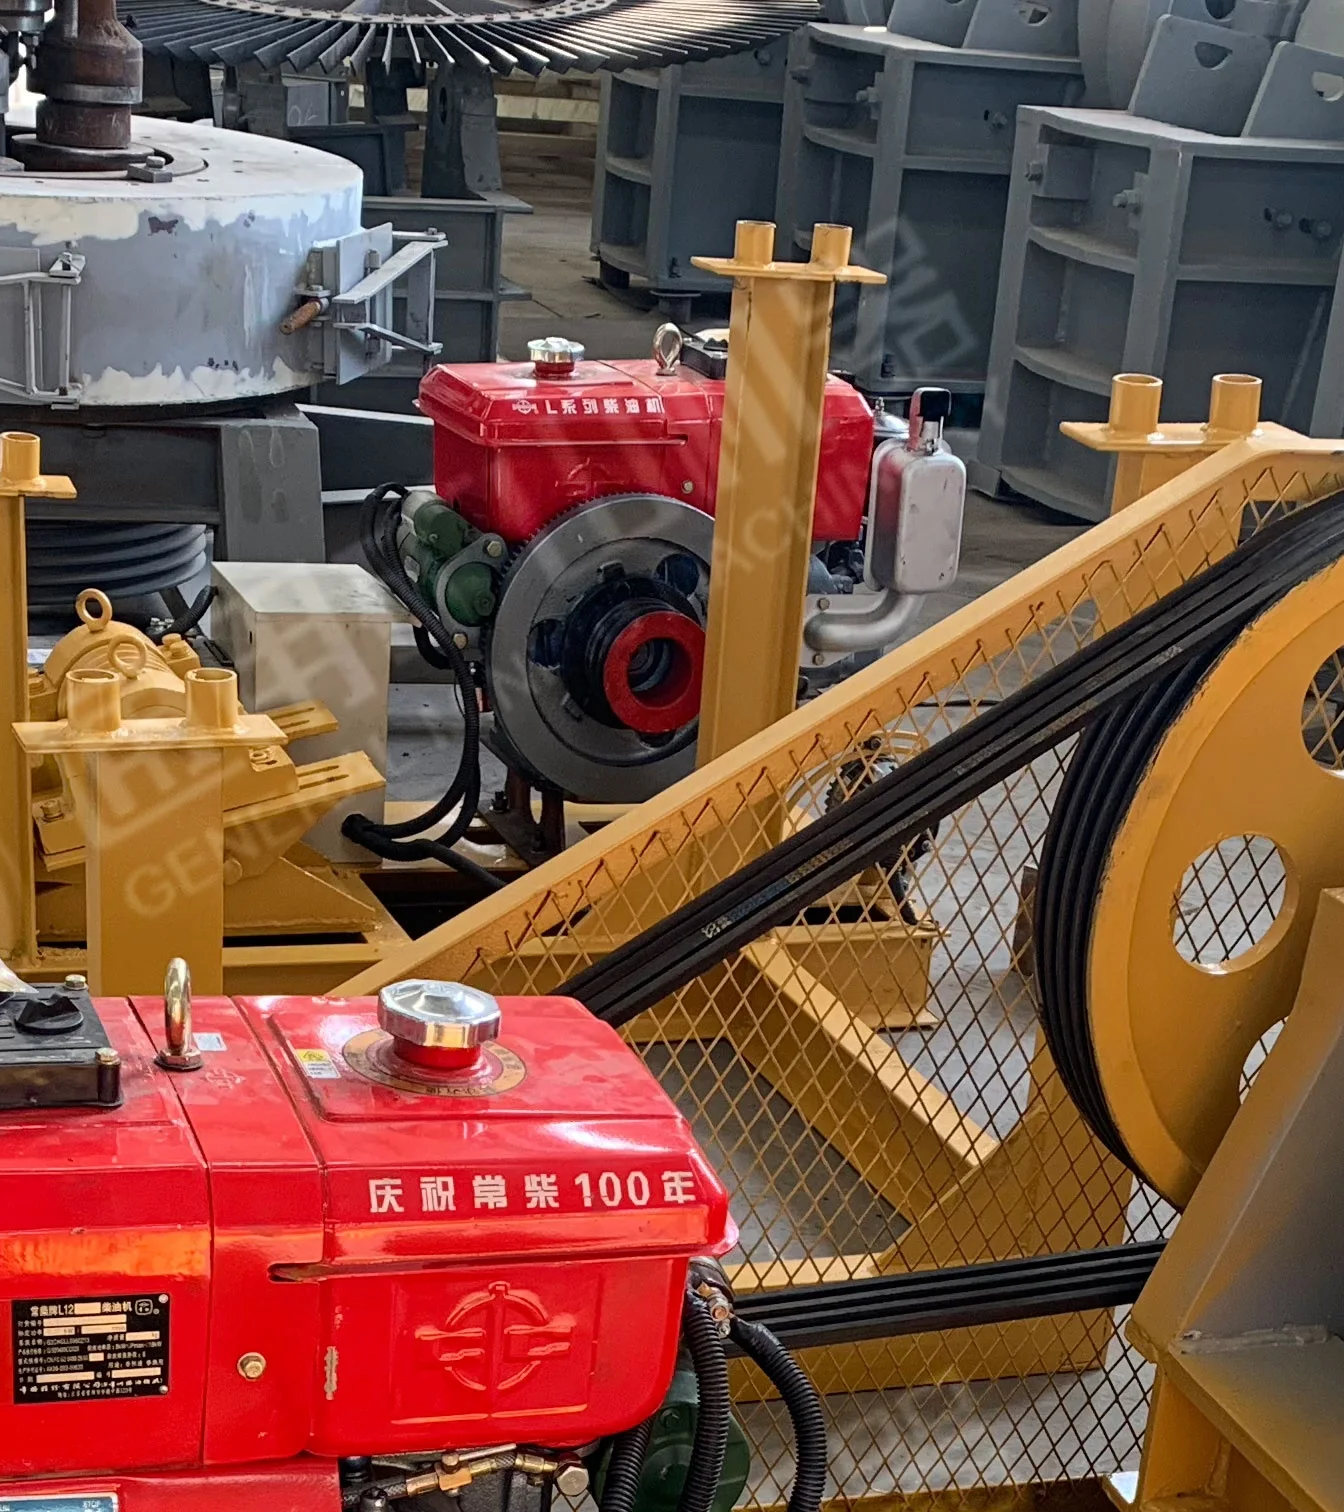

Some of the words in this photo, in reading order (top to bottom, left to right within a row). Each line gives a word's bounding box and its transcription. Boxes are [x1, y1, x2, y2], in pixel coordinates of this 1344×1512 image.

[544, 398, 665, 415] L系列柴油机
[368, 1170, 698, 1213] 庆祝常柴100年
